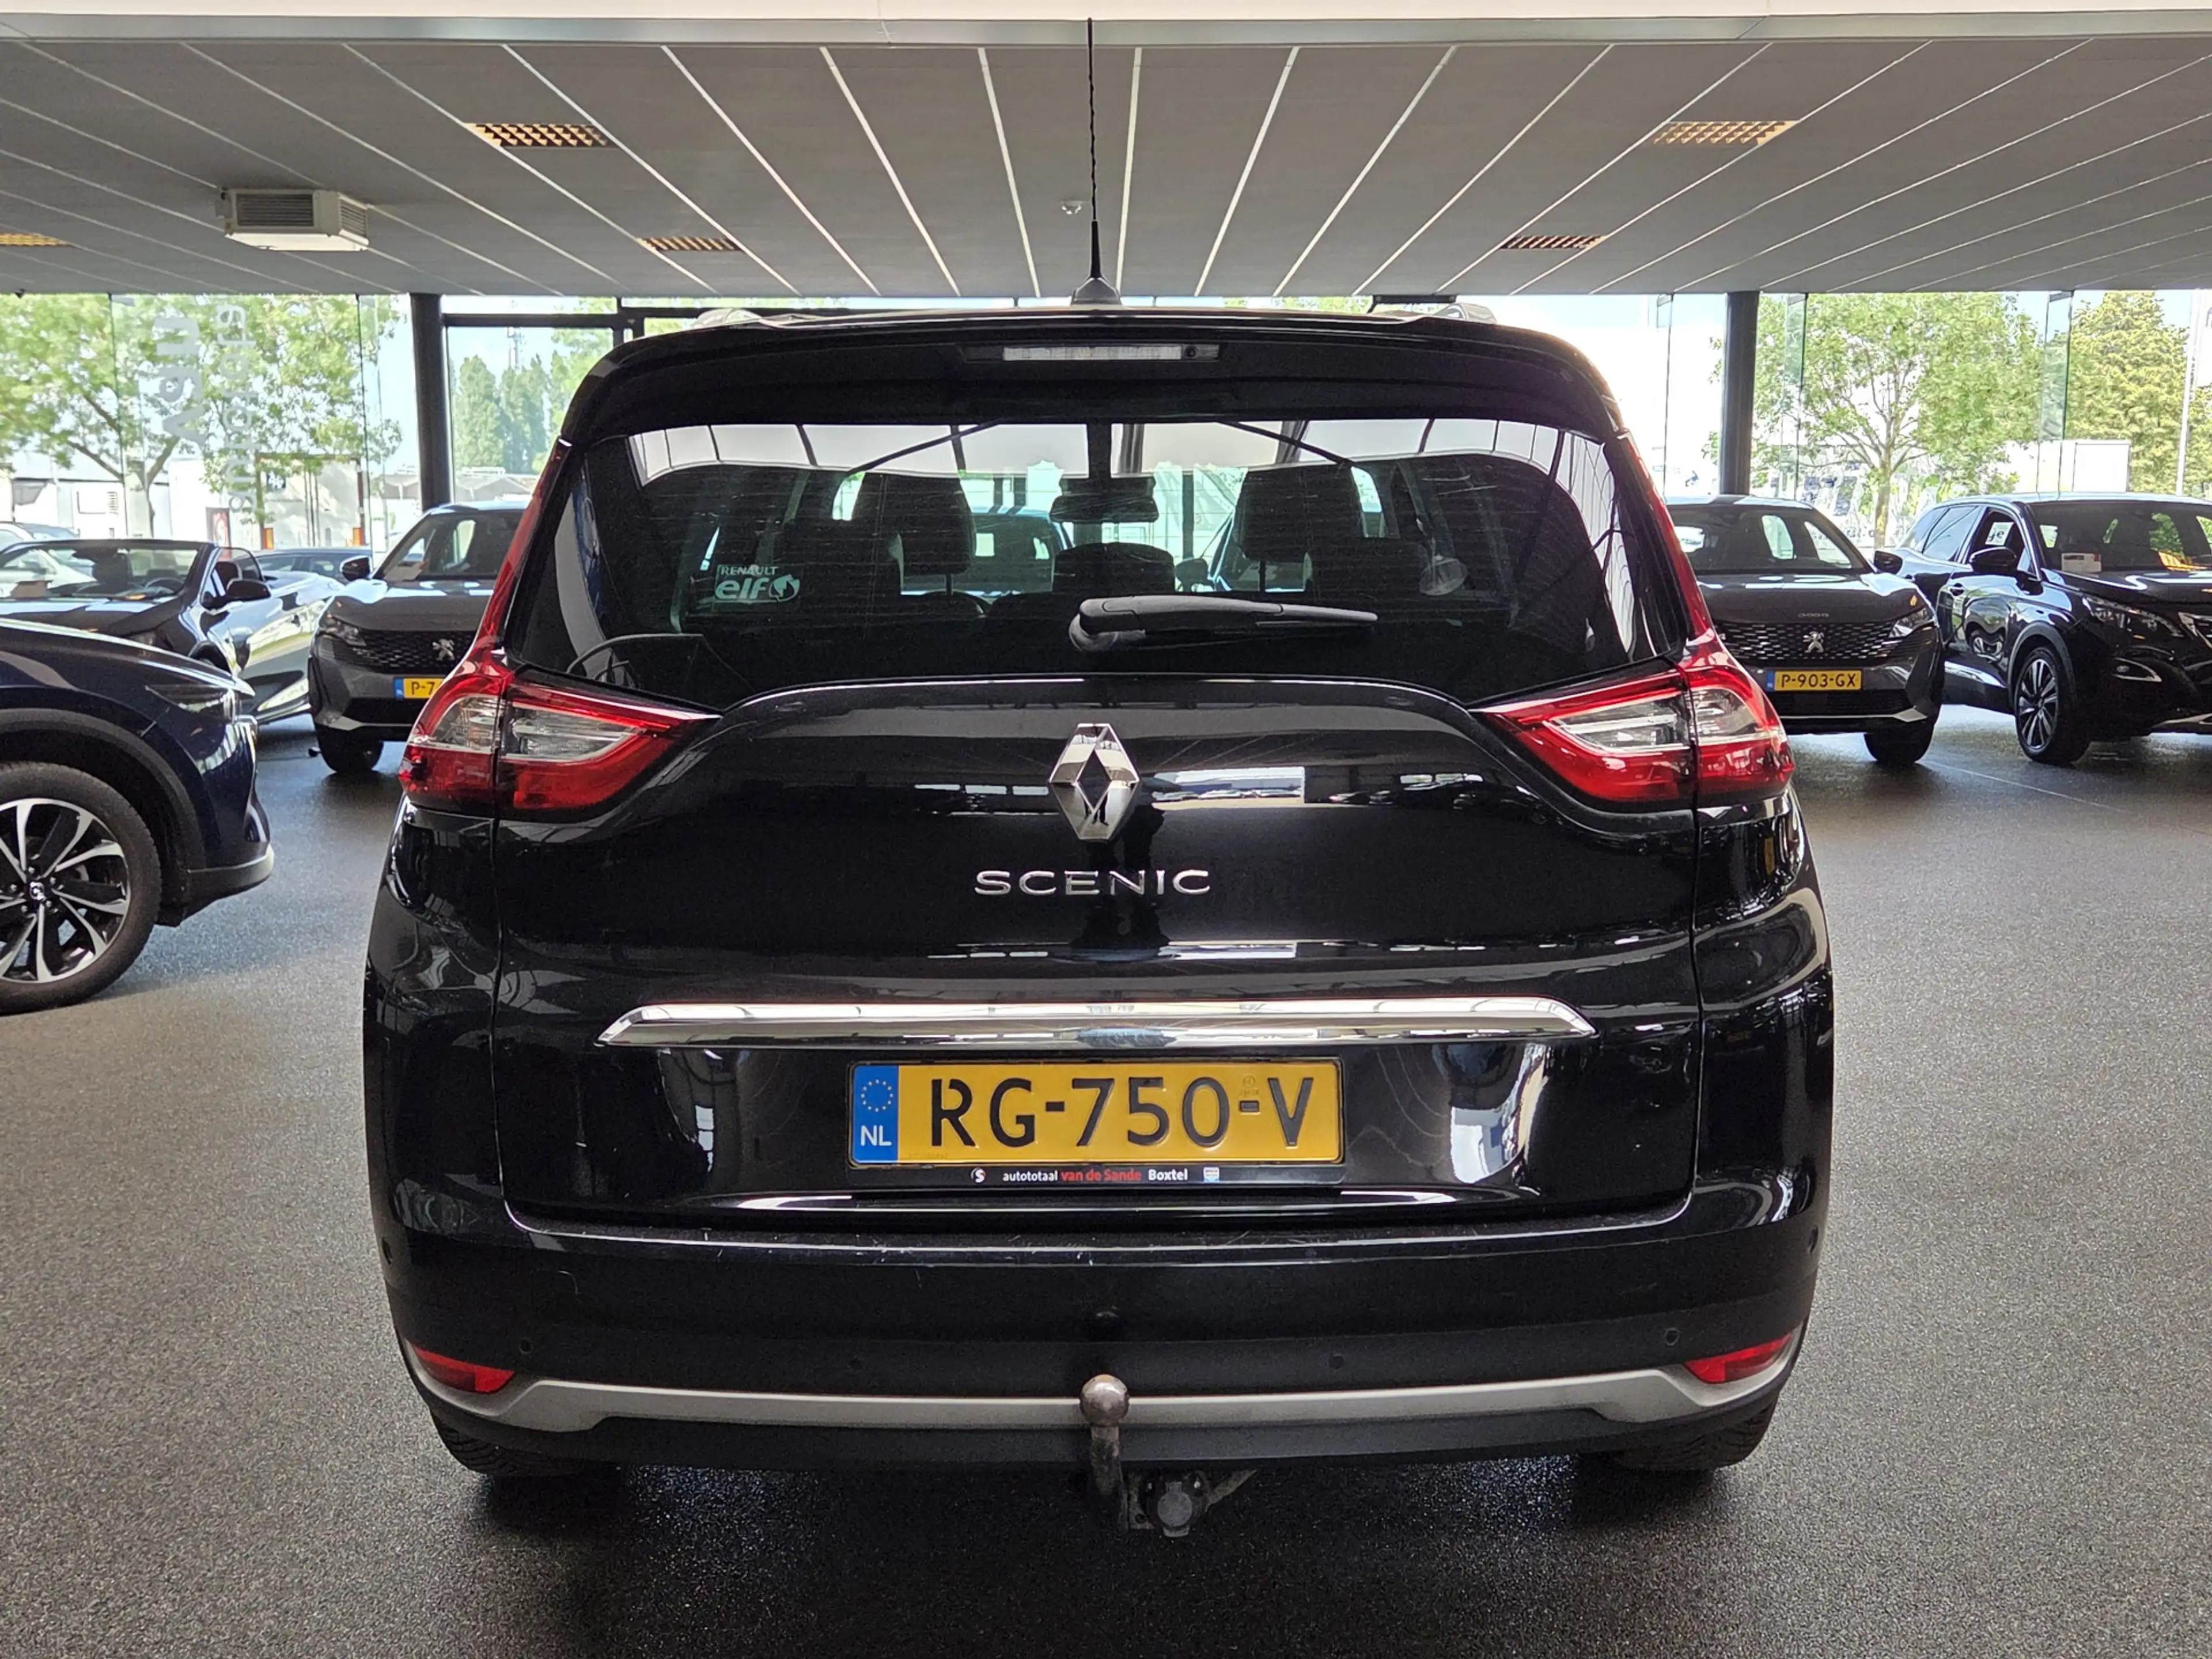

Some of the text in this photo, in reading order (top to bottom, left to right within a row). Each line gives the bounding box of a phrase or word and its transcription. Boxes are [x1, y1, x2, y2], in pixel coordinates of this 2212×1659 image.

[721, 566, 778, 575] RENAULT
[715, 577, 770, 600] elf
[1781, 673, 1857, 688] P-903-GX
[974, 869, 1211, 896] SCENIC
[931, 1077, 1314, 1147] RG-750-V
[860, 1125, 892, 1146] NL
[1003, 1169, 1058, 1182] autototaal
[1061, 1172, 1083, 1182] van
[1086, 1169, 1101, 1182] de
[1104, 1169, 1142, 1181] Sande
[1148, 1168, 1188, 1181] Boxtel
